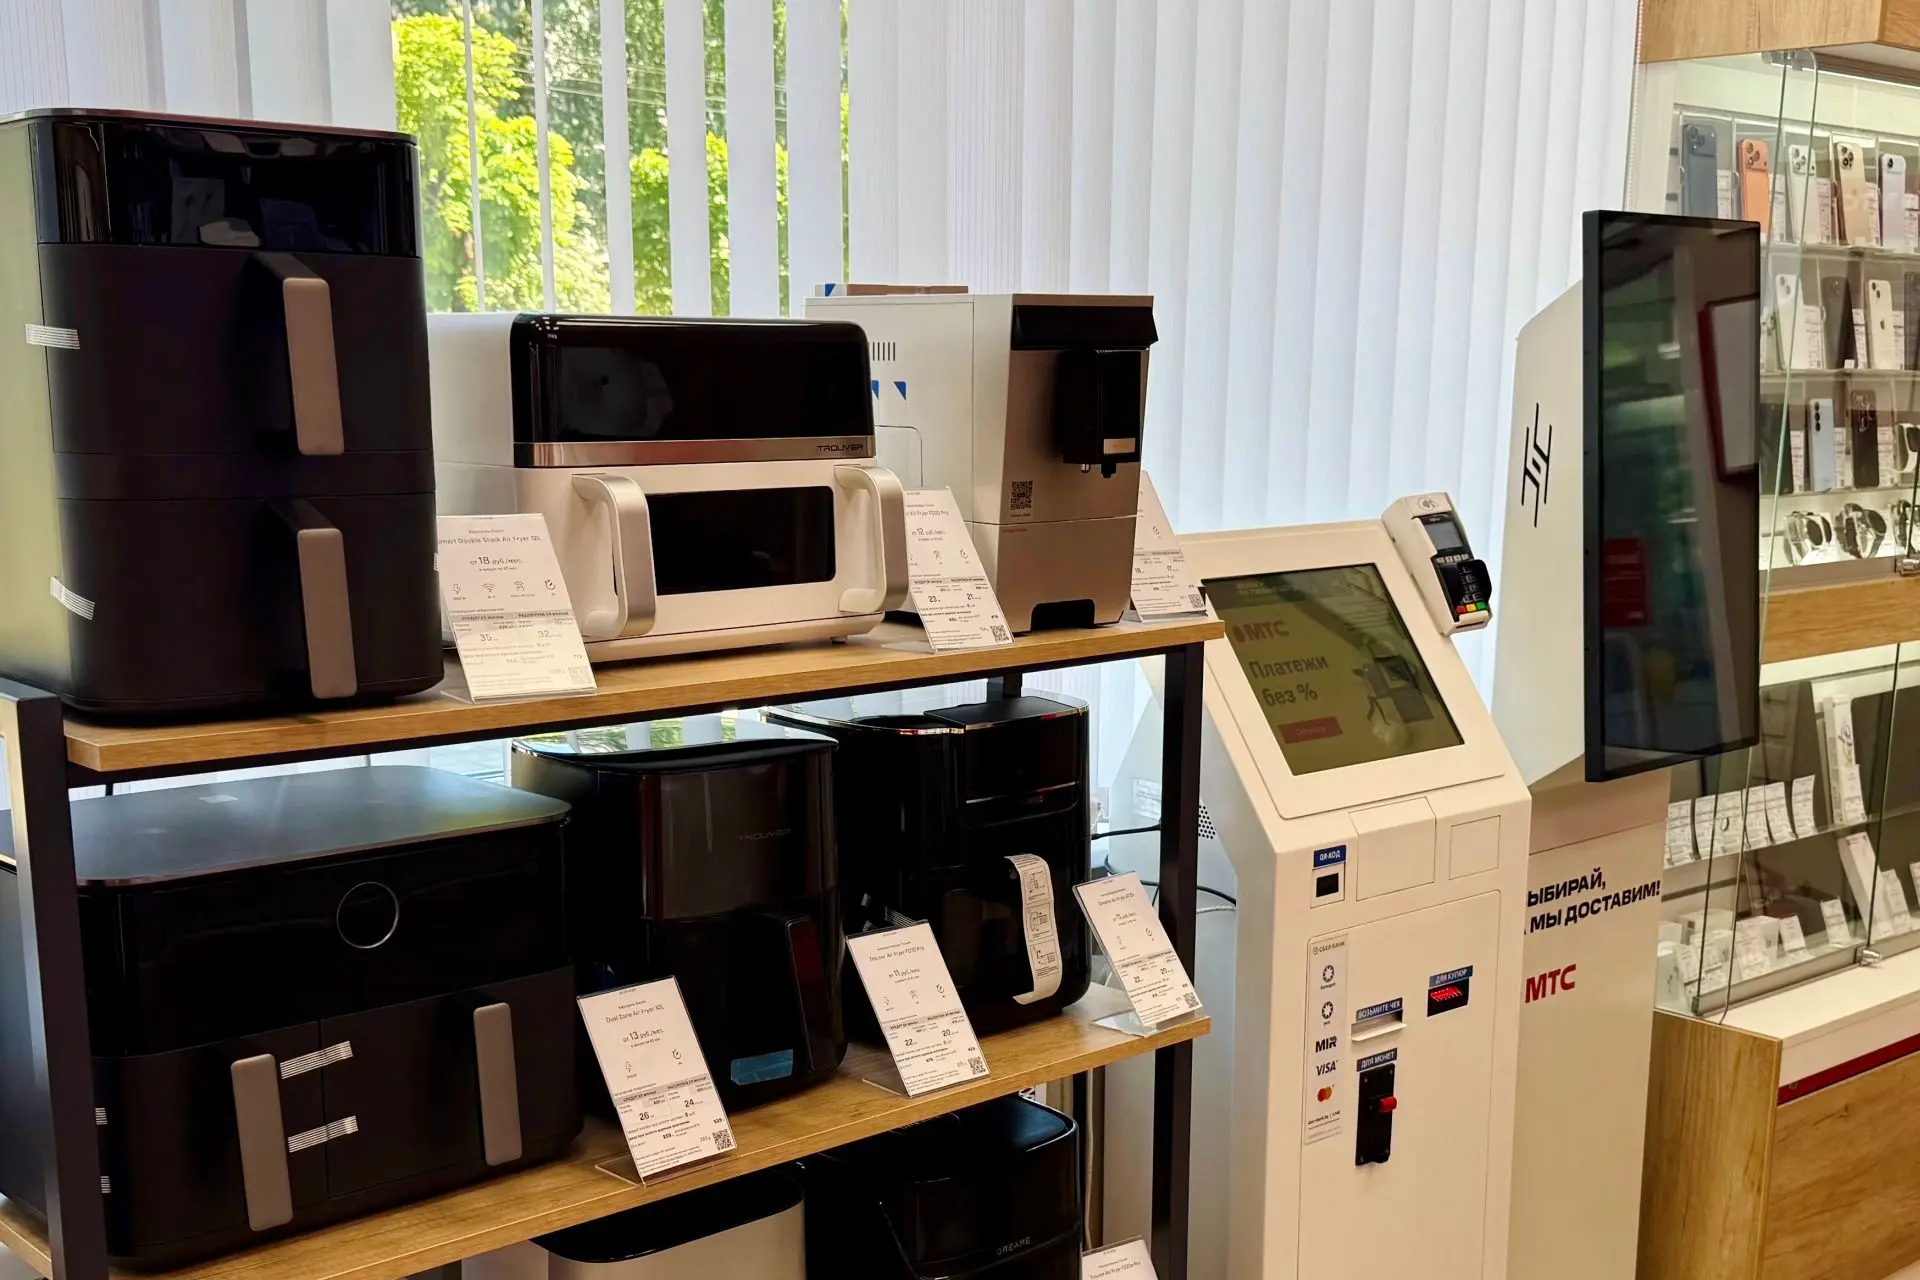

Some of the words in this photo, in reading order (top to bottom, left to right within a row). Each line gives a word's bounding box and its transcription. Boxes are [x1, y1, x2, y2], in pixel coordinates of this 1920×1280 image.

[816, 444, 864, 452] TROUVER
[478, 556, 490, 565] 18
[1243, 620, 1290, 641] МТС
[1249, 656, 1329, 679] Платежи
[1262, 687, 1297, 707] без
[1297, 682, 1318, 701] %
[1527, 867, 1606, 908] ЫБИРАЙ,
[1530, 909, 1562, 934] МЫ
[1564, 880, 1661, 926] ДОСТАВИМ!
[1448, 969, 1467, 980] КУПЮР
[1525, 963, 1577, 1004] МТС
[1358, 1003, 1388, 1018] ВОЗЬМИТЕ
[1390, 1000, 1400, 1011] ЧЕК
[629, 1031, 639, 1041] 13
[942, 1029, 951, 1037] 20
[1315, 1036, 1337, 1053] MIR
[1361, 1057, 1374, 1068] ДЛЯ
[1375, 1051, 1395, 1063] МОНЕТ
[1316, 1061, 1336, 1076] VISA
[684, 1098, 695, 1108] 24
[639, 1111, 650, 1121] 26
[996, 1236, 1031, 1256] DREAME
